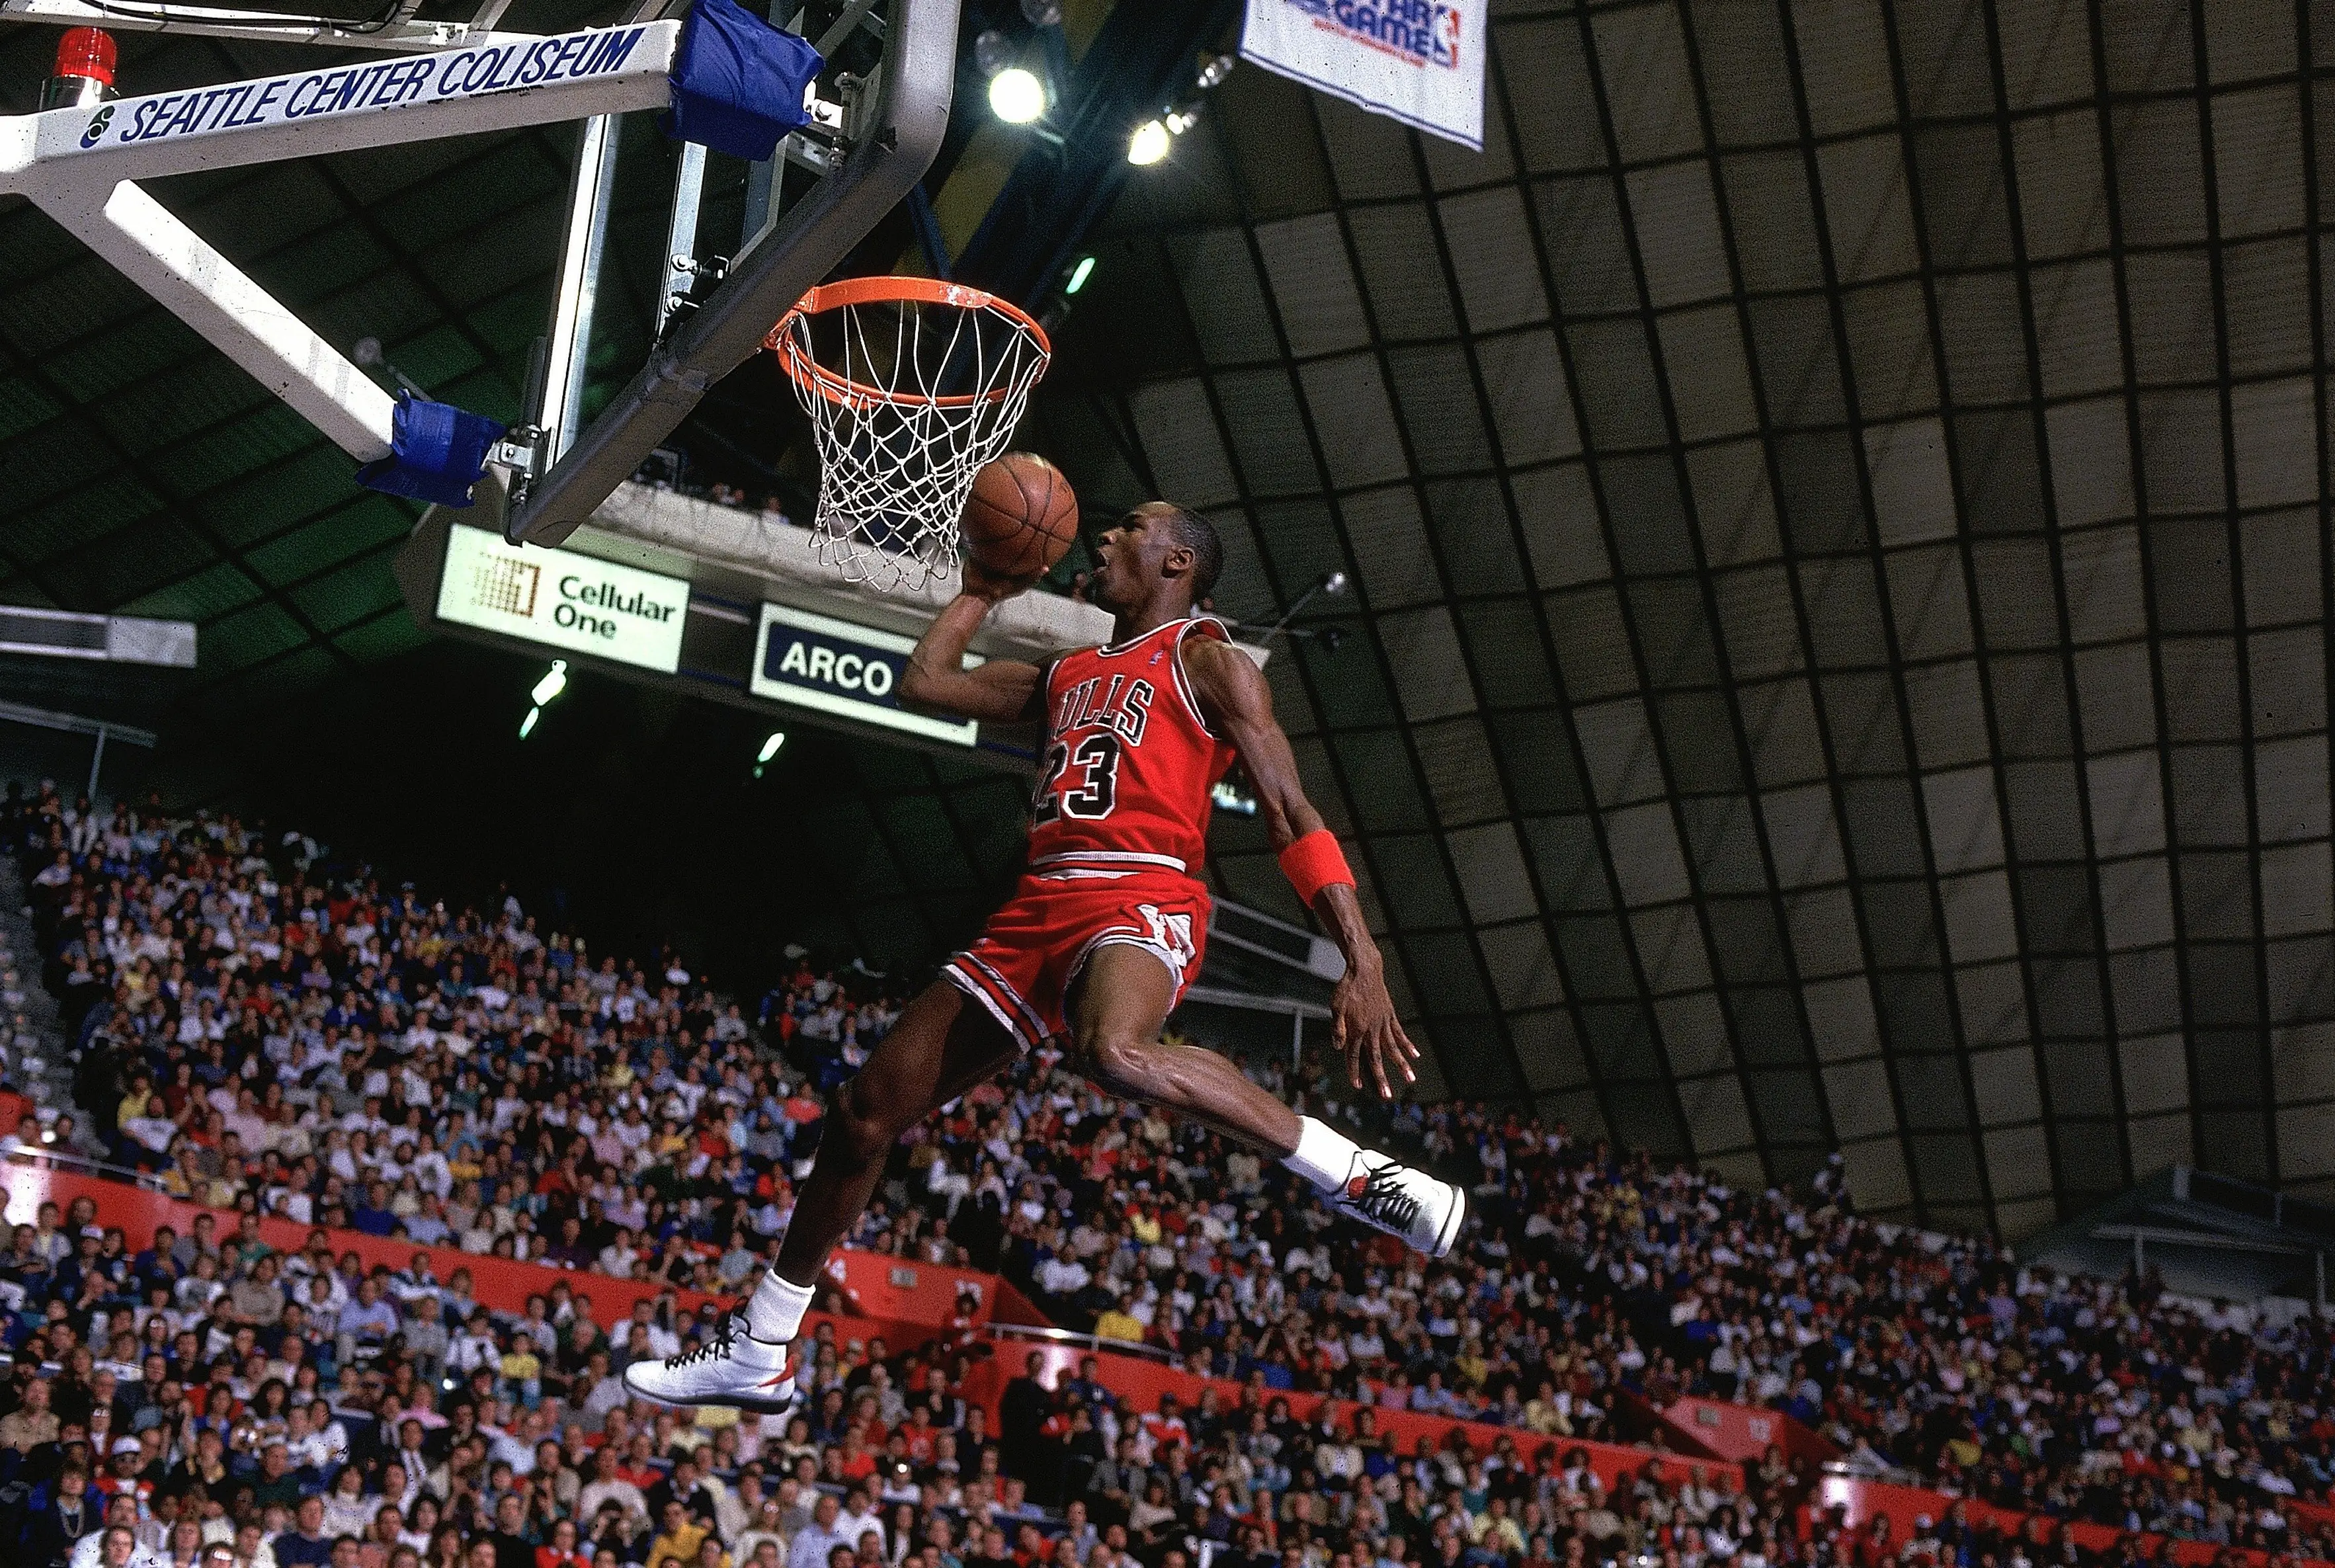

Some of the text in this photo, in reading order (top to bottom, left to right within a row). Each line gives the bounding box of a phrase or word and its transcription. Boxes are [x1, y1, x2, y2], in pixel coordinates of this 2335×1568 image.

[120, 27, 646, 142] SEATTLE CENTER COLISEUM
[554, 603, 617, 640] One
[559, 575, 676, 624] Cellular
[780, 641, 893, 696] ARCO
[1032, 731, 1121, 833] 23
